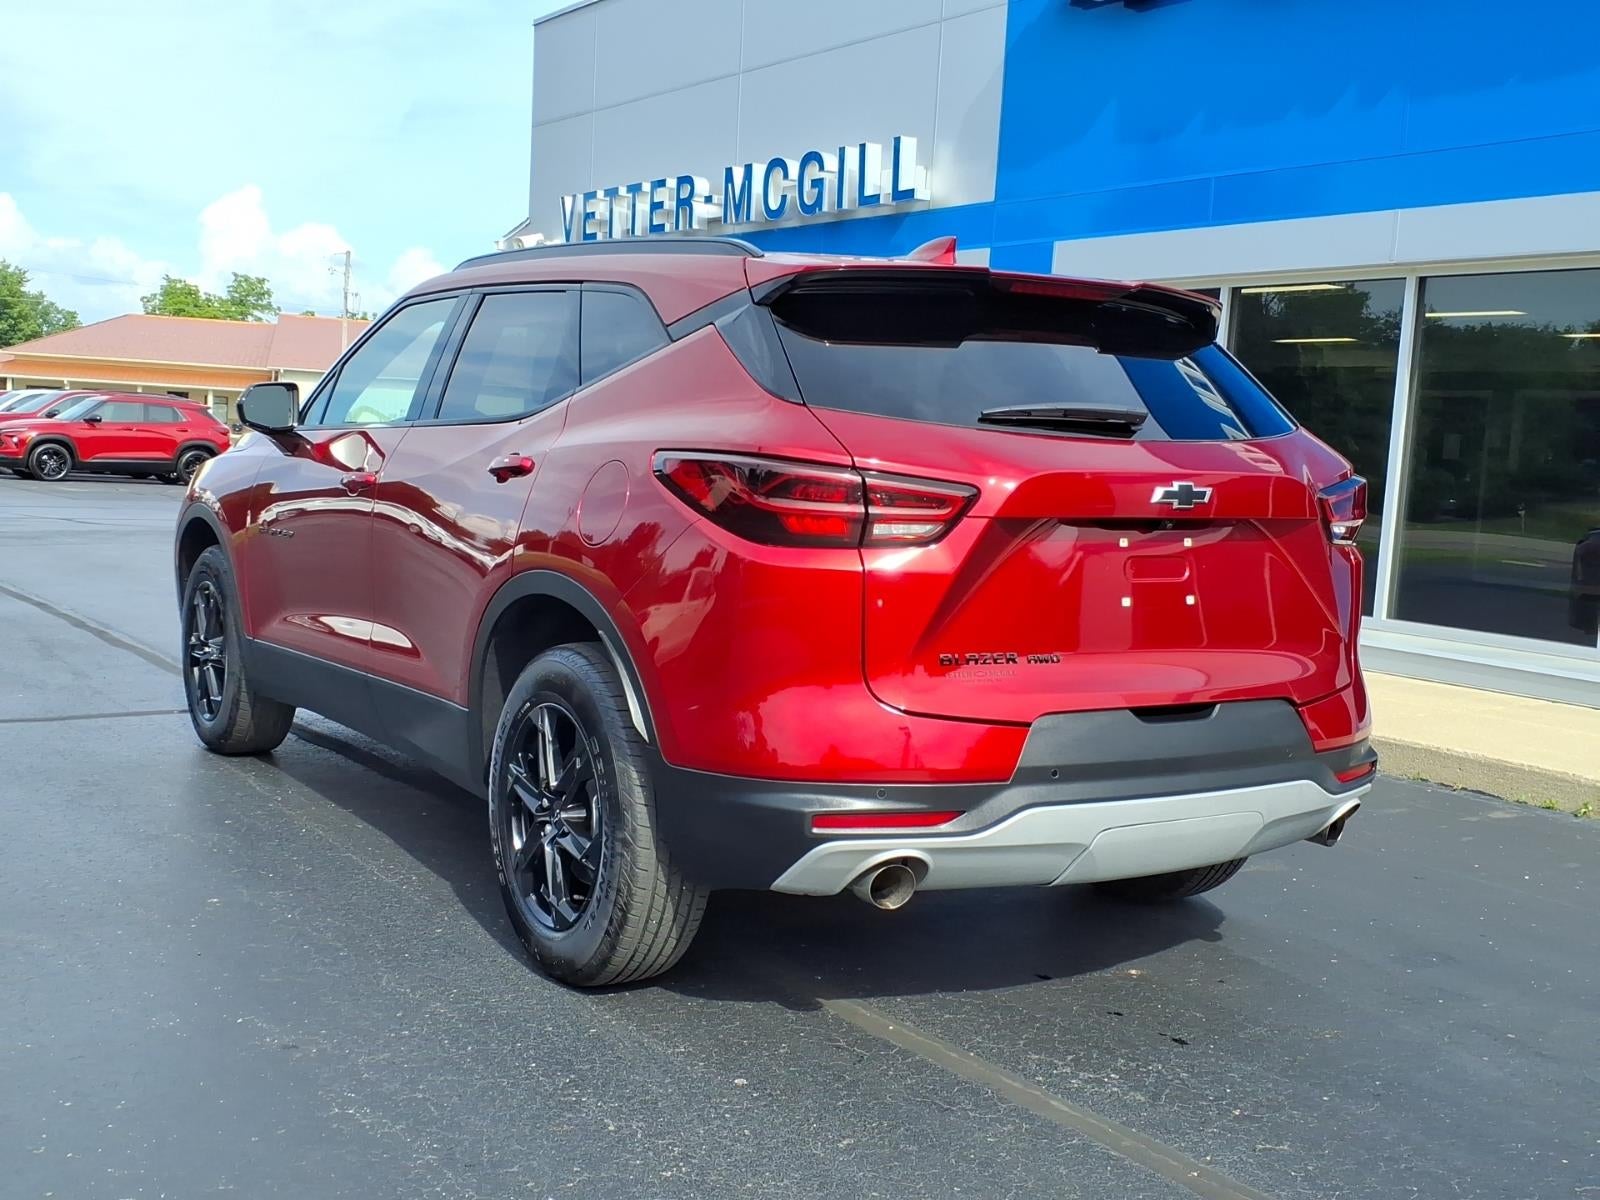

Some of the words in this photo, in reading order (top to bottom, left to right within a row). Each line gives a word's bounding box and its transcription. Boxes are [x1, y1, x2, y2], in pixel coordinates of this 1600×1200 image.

[560, 135, 926, 243] VETTER-MCGILL
[939, 651, 1018, 666] BLAZER
[1027, 653, 1061, 665] AWD
